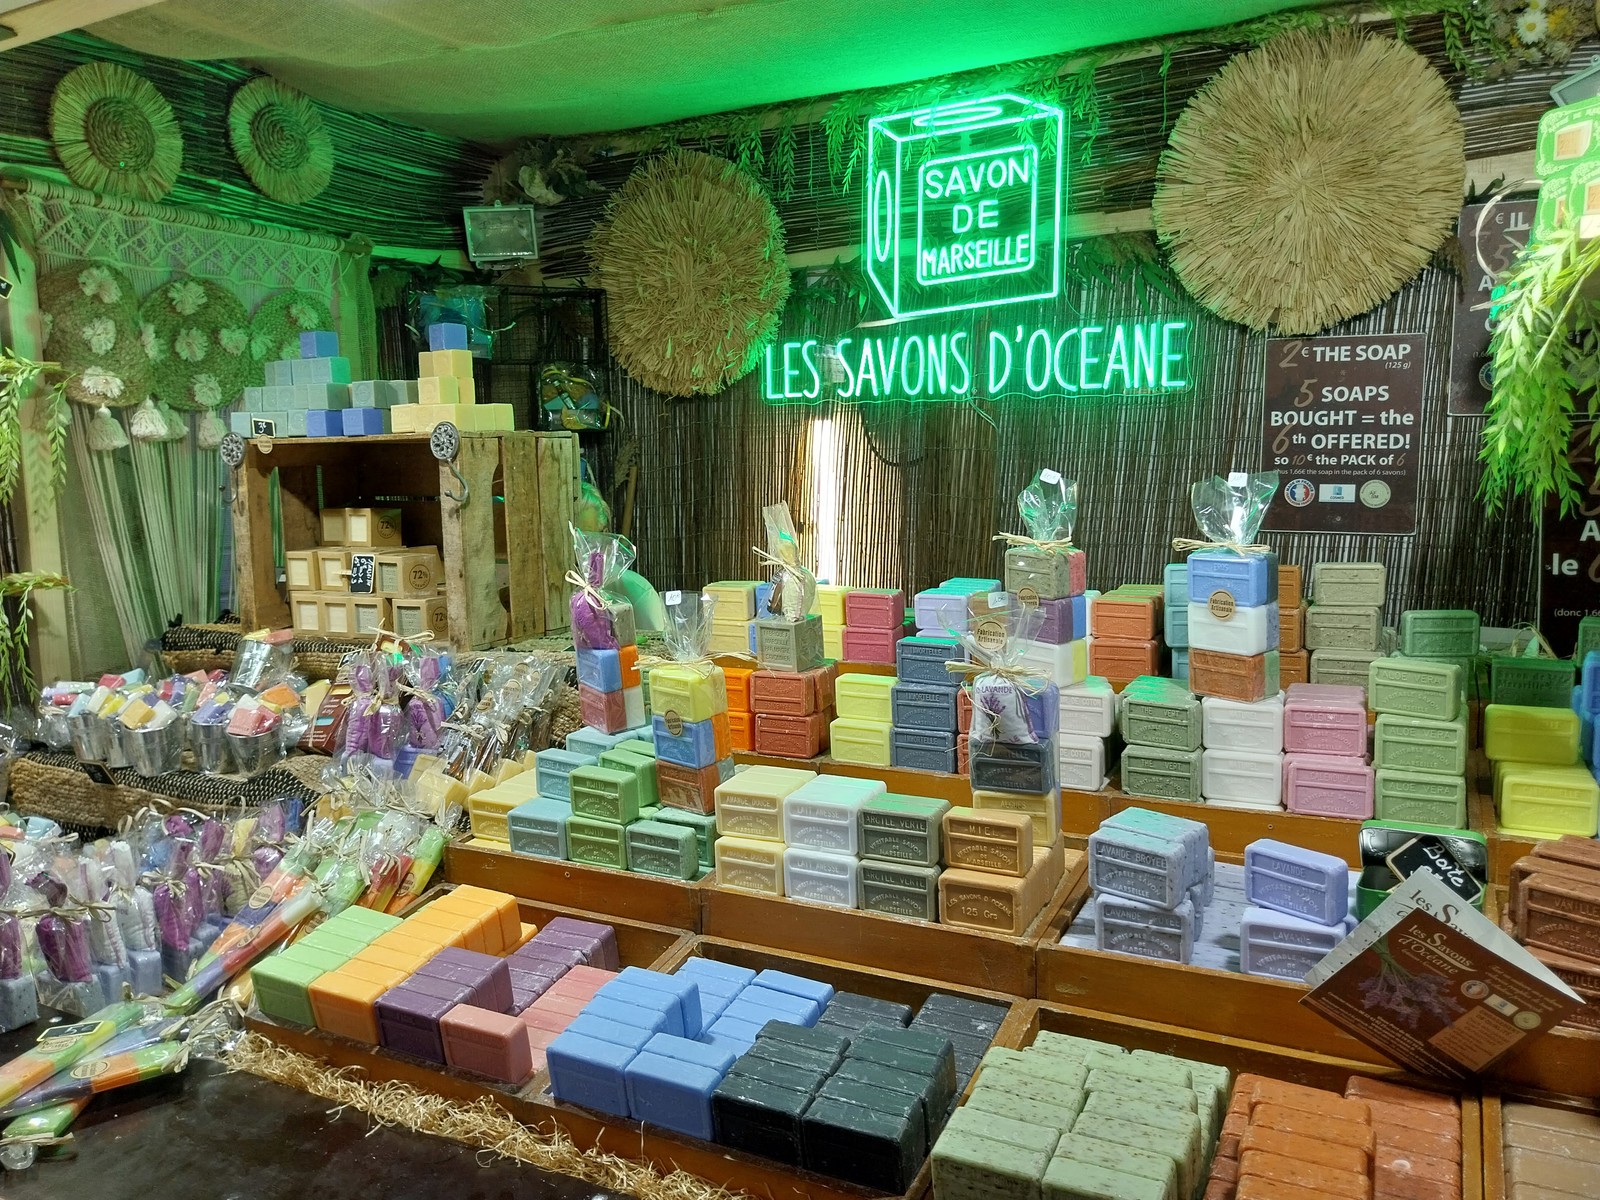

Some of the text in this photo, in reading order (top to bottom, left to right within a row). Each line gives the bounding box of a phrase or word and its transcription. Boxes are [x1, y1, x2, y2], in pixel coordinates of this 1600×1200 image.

[924, 157, 1030, 199] SAVON
[952, 200, 999, 234] DE
[921, 233, 1030, 276] MARSEILLE
[765, 322, 1186, 400] LES SAVONS D'OCEANE
[1313, 346, 1351, 362] THE
[1355, 344, 1411, 360] SOAP
[1294, 379, 1389, 407] 5 SOAPS
[1270, 411, 1357, 426] BOUGHT
[1380, 409, 1413, 425] the
[1311, 433, 1411, 449] OFFERED!
[1274, 456, 1289, 465] so
[1315, 454, 1337, 465] the
[1340, 455, 1375, 465] PACK
[1379, 454, 1394, 465] of
[1397, 453, 1406, 467] 6
[1552, 553, 1579, 576] le
[1210, 598, 1233, 606] Fabrication
[1554, 609, 1581, 617] (donc
[977, 628, 1005, 638] Fabrication
[1383, 671, 1442, 685] ALOE VERA
[1390, 726, 1451, 739] ALOE VERA
[1389, 781, 1451, 795] ALOE VERA
[899, 819, 926, 830] VERTE
[1096, 843, 1167, 868] LAVANDE BROYEE
[1272, 862, 1305, 878] LAVANDE
[947, 898, 958, 907] LES
[959, 893, 981, 901] SAVONS
[1410, 889, 1432, 911] les
[961, 906, 978, 917] 125
[1409, 925, 1426, 939] les
[1426, 932, 1473, 967] Savons
